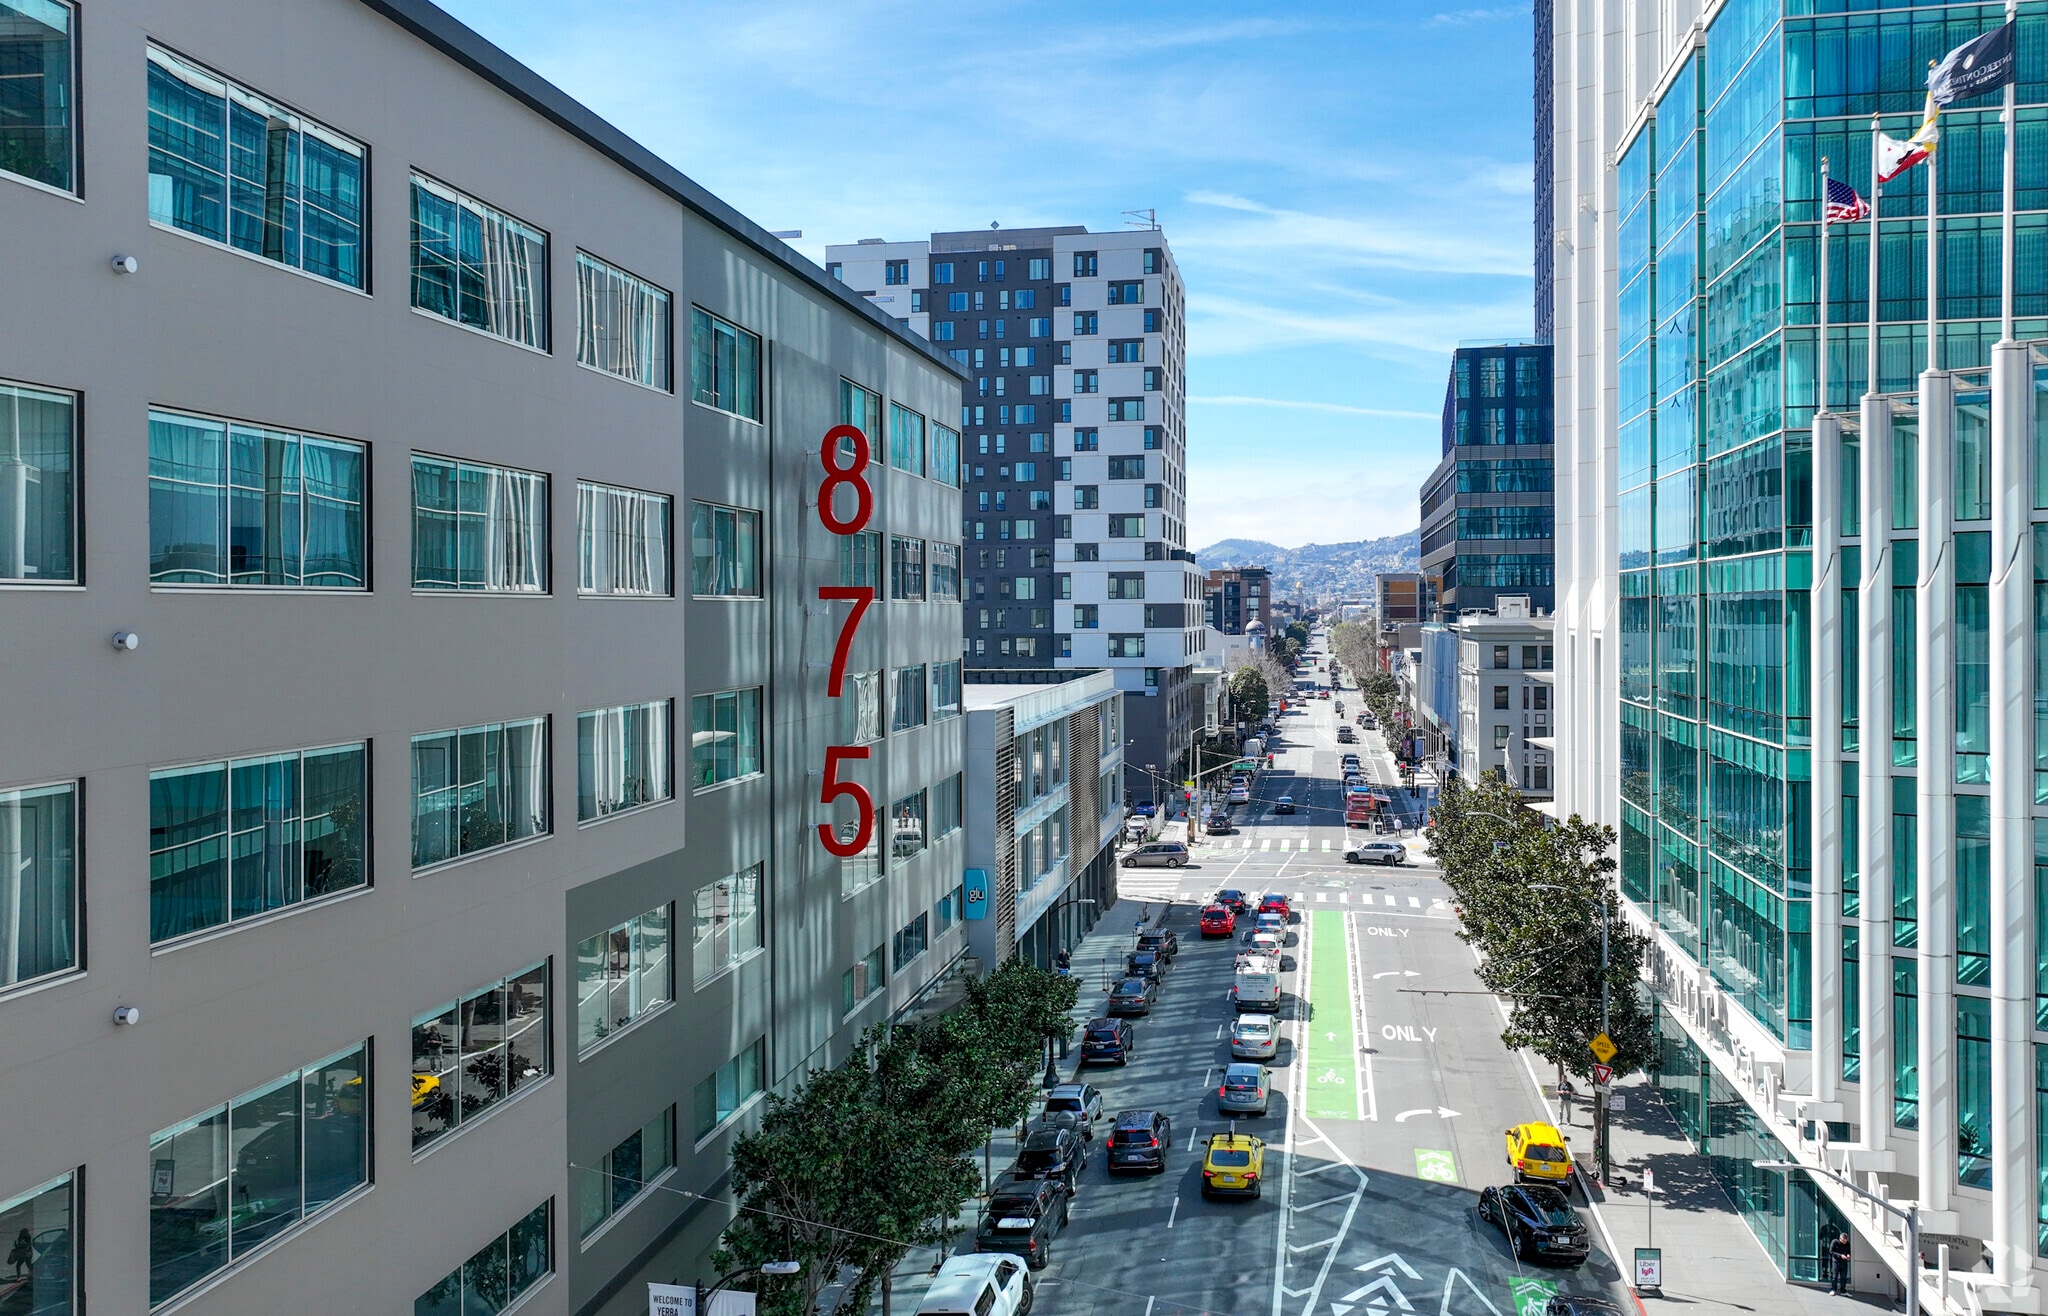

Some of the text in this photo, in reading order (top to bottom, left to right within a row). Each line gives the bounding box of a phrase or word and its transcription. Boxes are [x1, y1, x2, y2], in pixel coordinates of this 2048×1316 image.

[968, 887, 985, 902] glu
[1367, 926, 1410, 938] ONLY
[1381, 1024, 1438, 1043] ONLY
[1596, 1040, 1610, 1049] SPEED
[1641, 1268, 1654, 1276] lyft
[653, 1295, 692, 1307] WELCOME TO
[657, 1307, 678, 1316] YERBA
